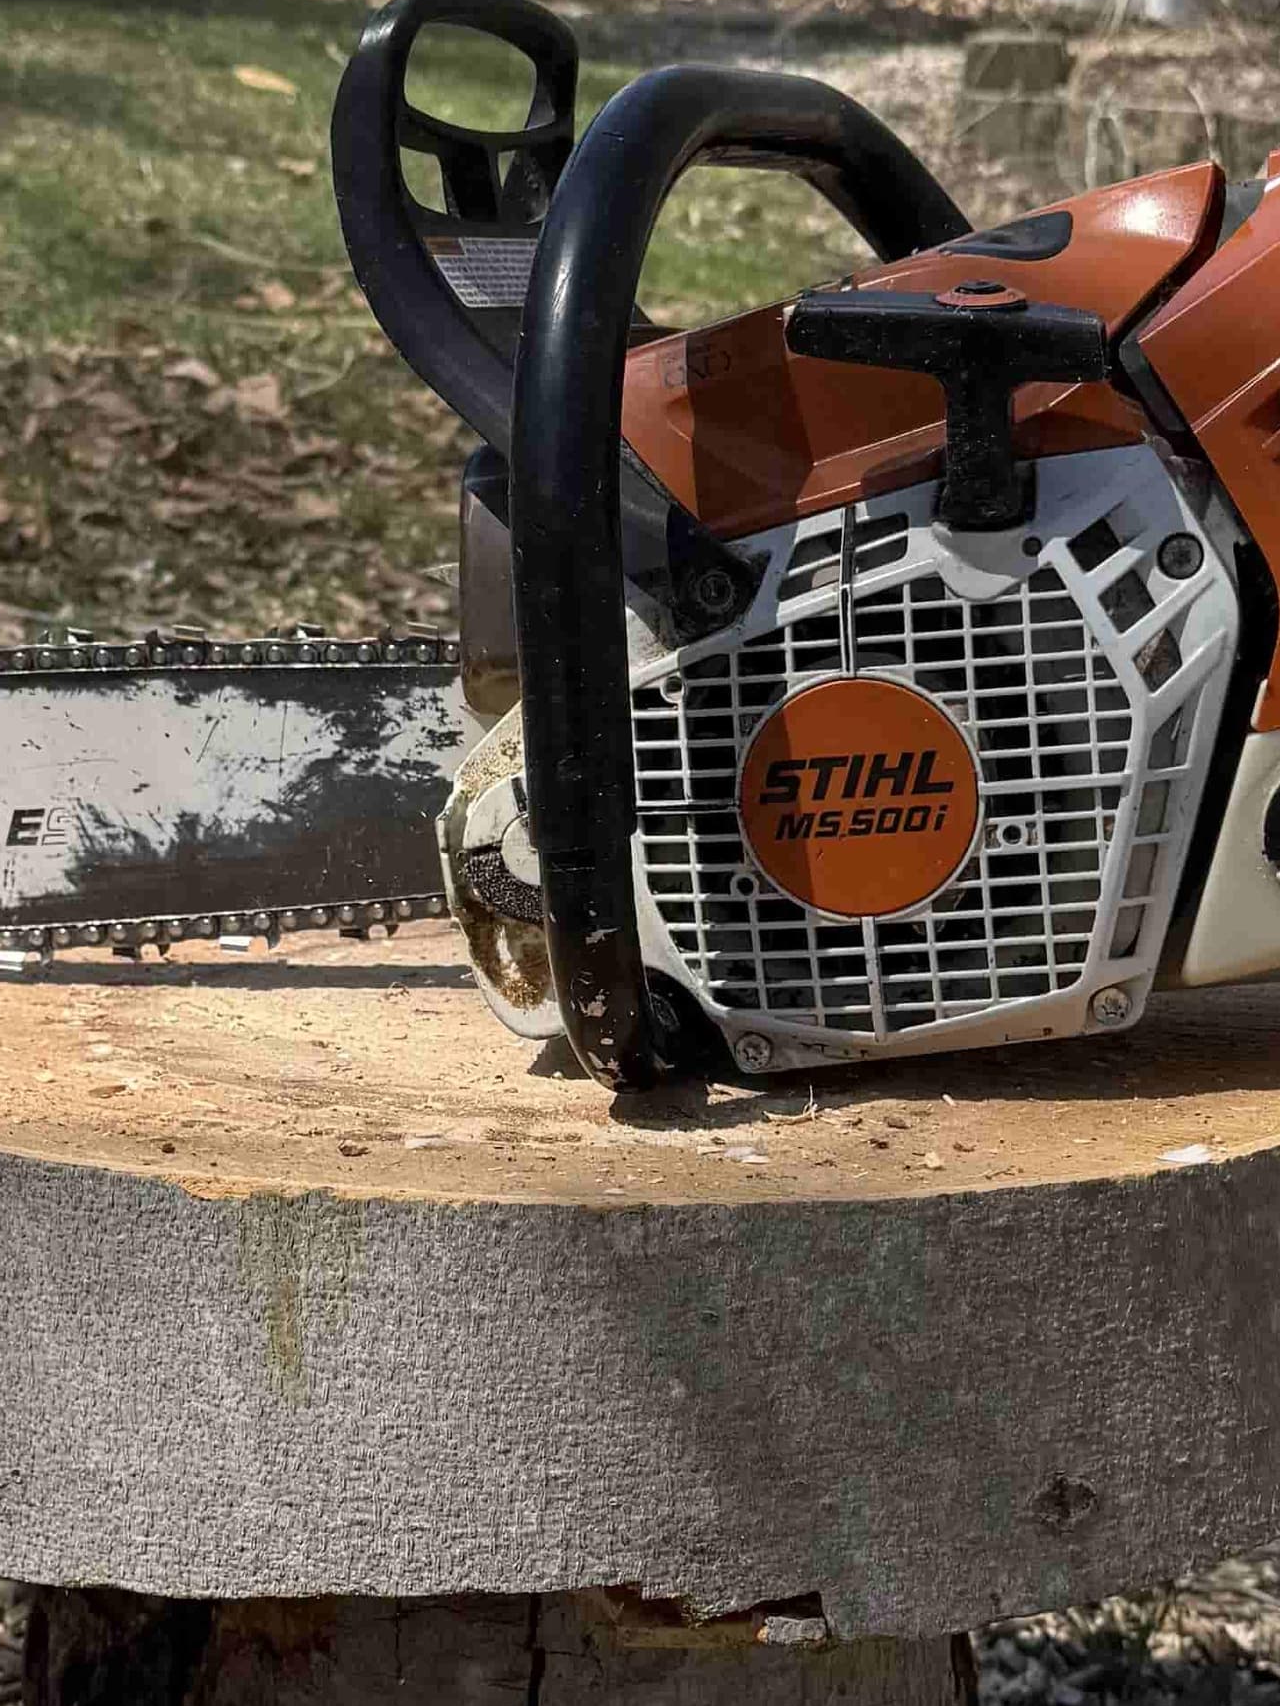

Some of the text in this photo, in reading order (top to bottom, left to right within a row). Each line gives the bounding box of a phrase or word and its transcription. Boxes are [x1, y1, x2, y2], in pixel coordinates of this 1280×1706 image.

[759, 750, 954, 805] STIHL
[775, 804, 948, 840] MS 500i
